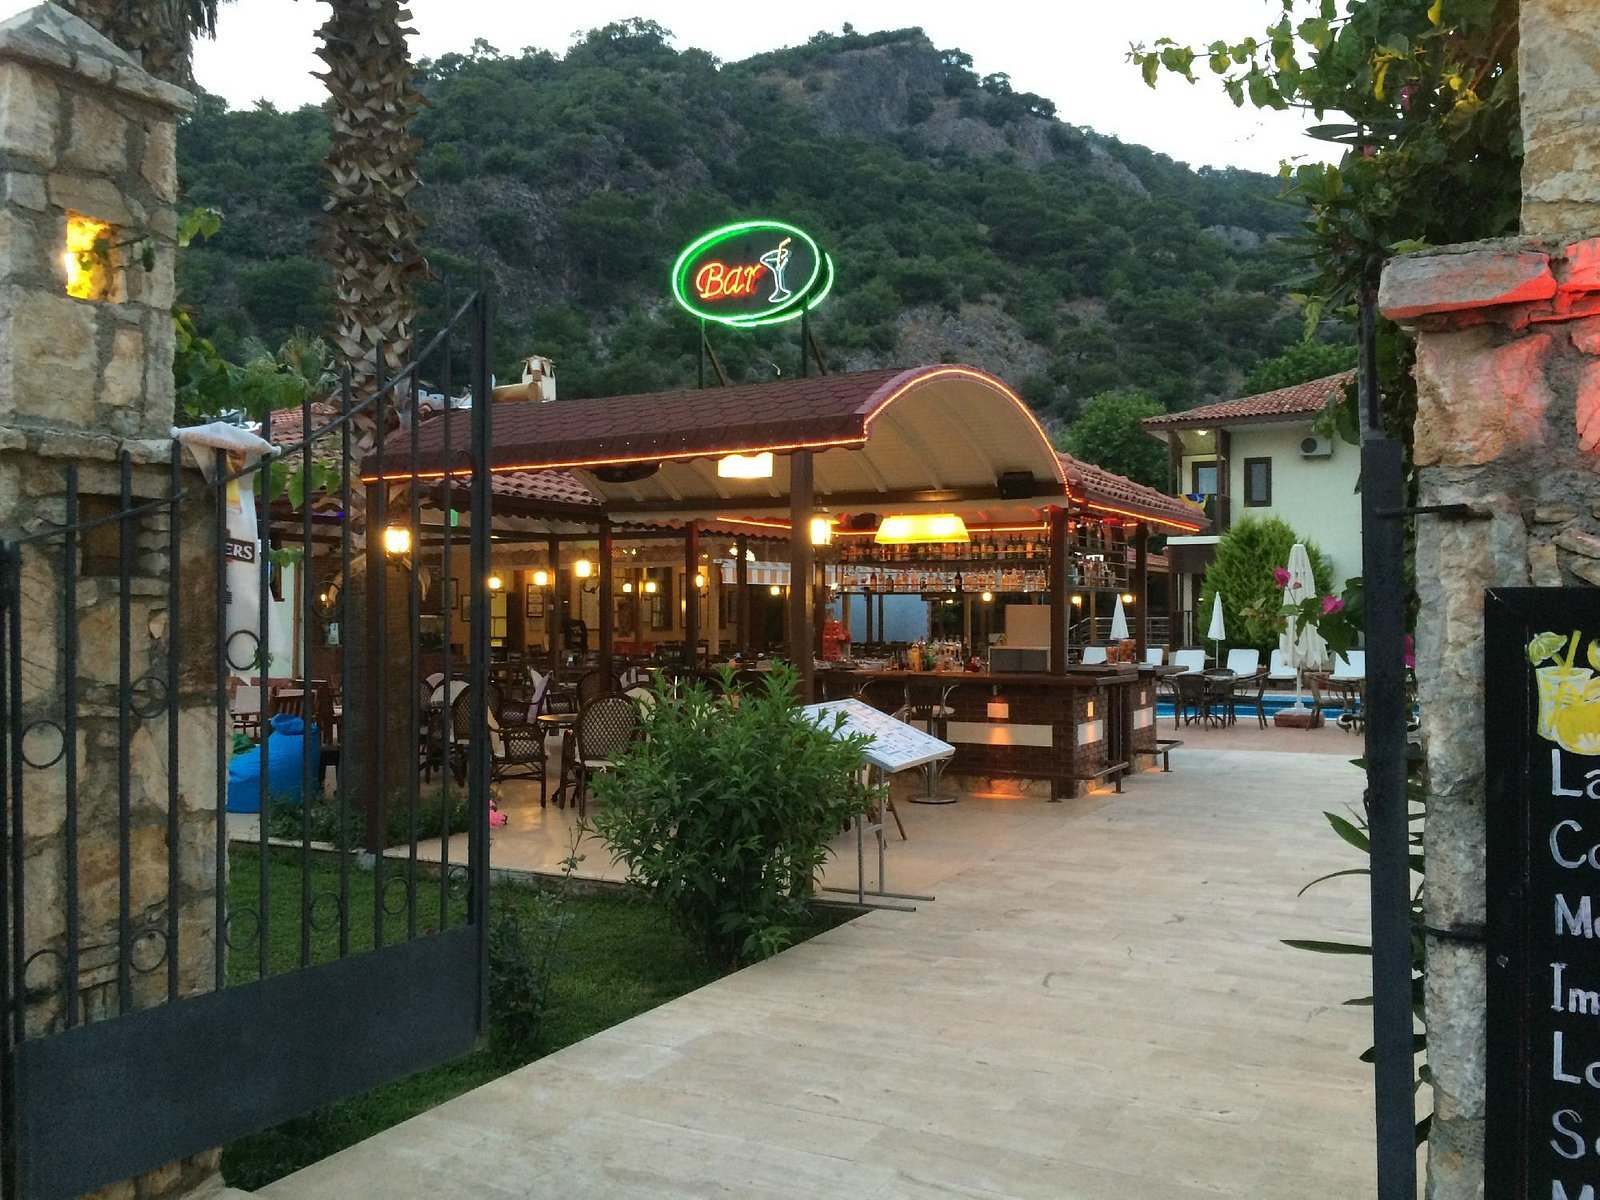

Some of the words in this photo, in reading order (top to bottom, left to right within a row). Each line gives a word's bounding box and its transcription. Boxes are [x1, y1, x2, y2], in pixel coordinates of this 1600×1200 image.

[696, 262, 763, 299] Bar
[1554, 893, 1600, 939] M
[1550, 1109, 1600, 1160] S
